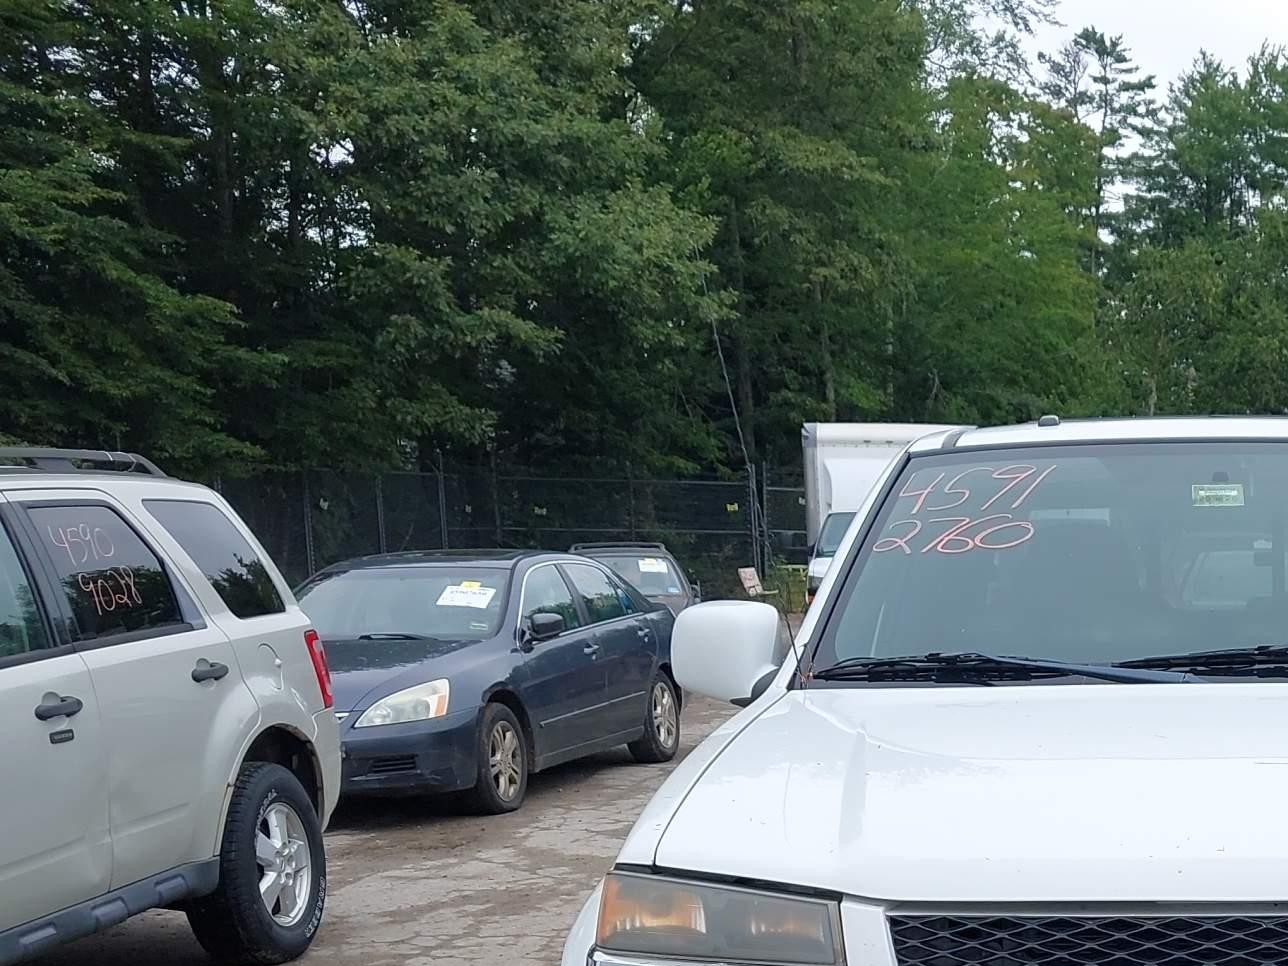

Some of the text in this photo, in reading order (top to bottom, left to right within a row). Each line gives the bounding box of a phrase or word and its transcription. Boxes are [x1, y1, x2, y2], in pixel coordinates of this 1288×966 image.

[899, 464, 1057, 514] 4591
[47, 523, 115, 567] 4590
[872, 513, 1035, 554] 2760
[78, 565, 142, 616] 9028
